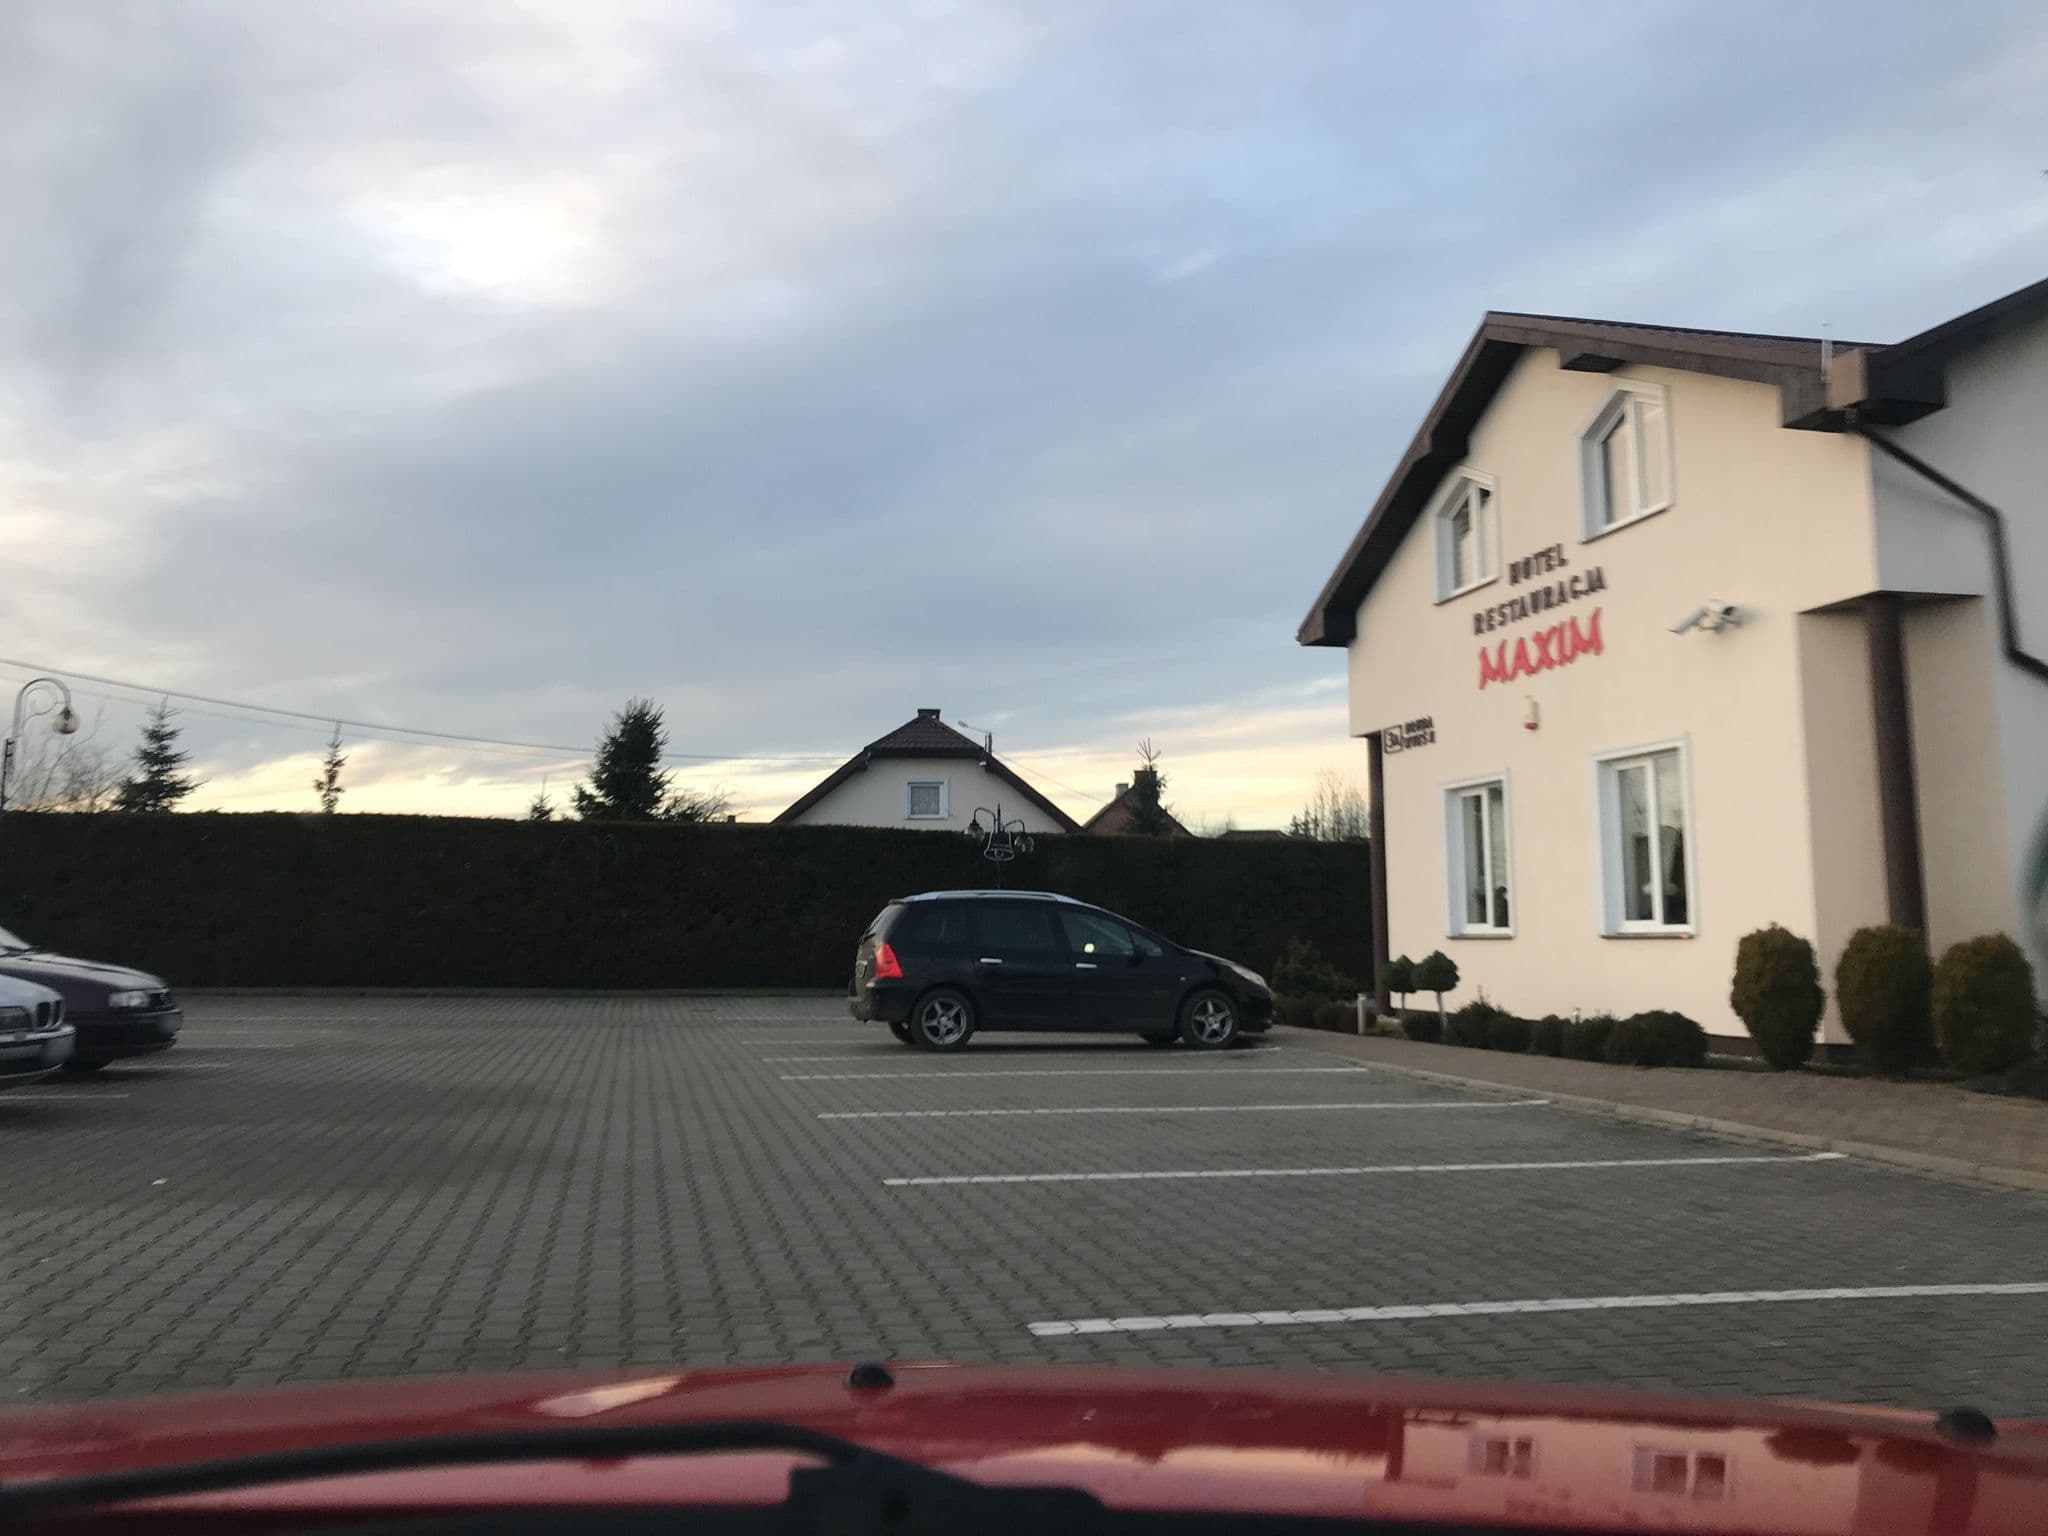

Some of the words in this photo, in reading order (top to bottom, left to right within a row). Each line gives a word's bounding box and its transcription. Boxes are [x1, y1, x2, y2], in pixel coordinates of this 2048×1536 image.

[1509, 543, 1567, 585] HOTEL
[1474, 566, 1606, 635] RESTAURACJA
[1479, 608, 1603, 689] MAXIM
